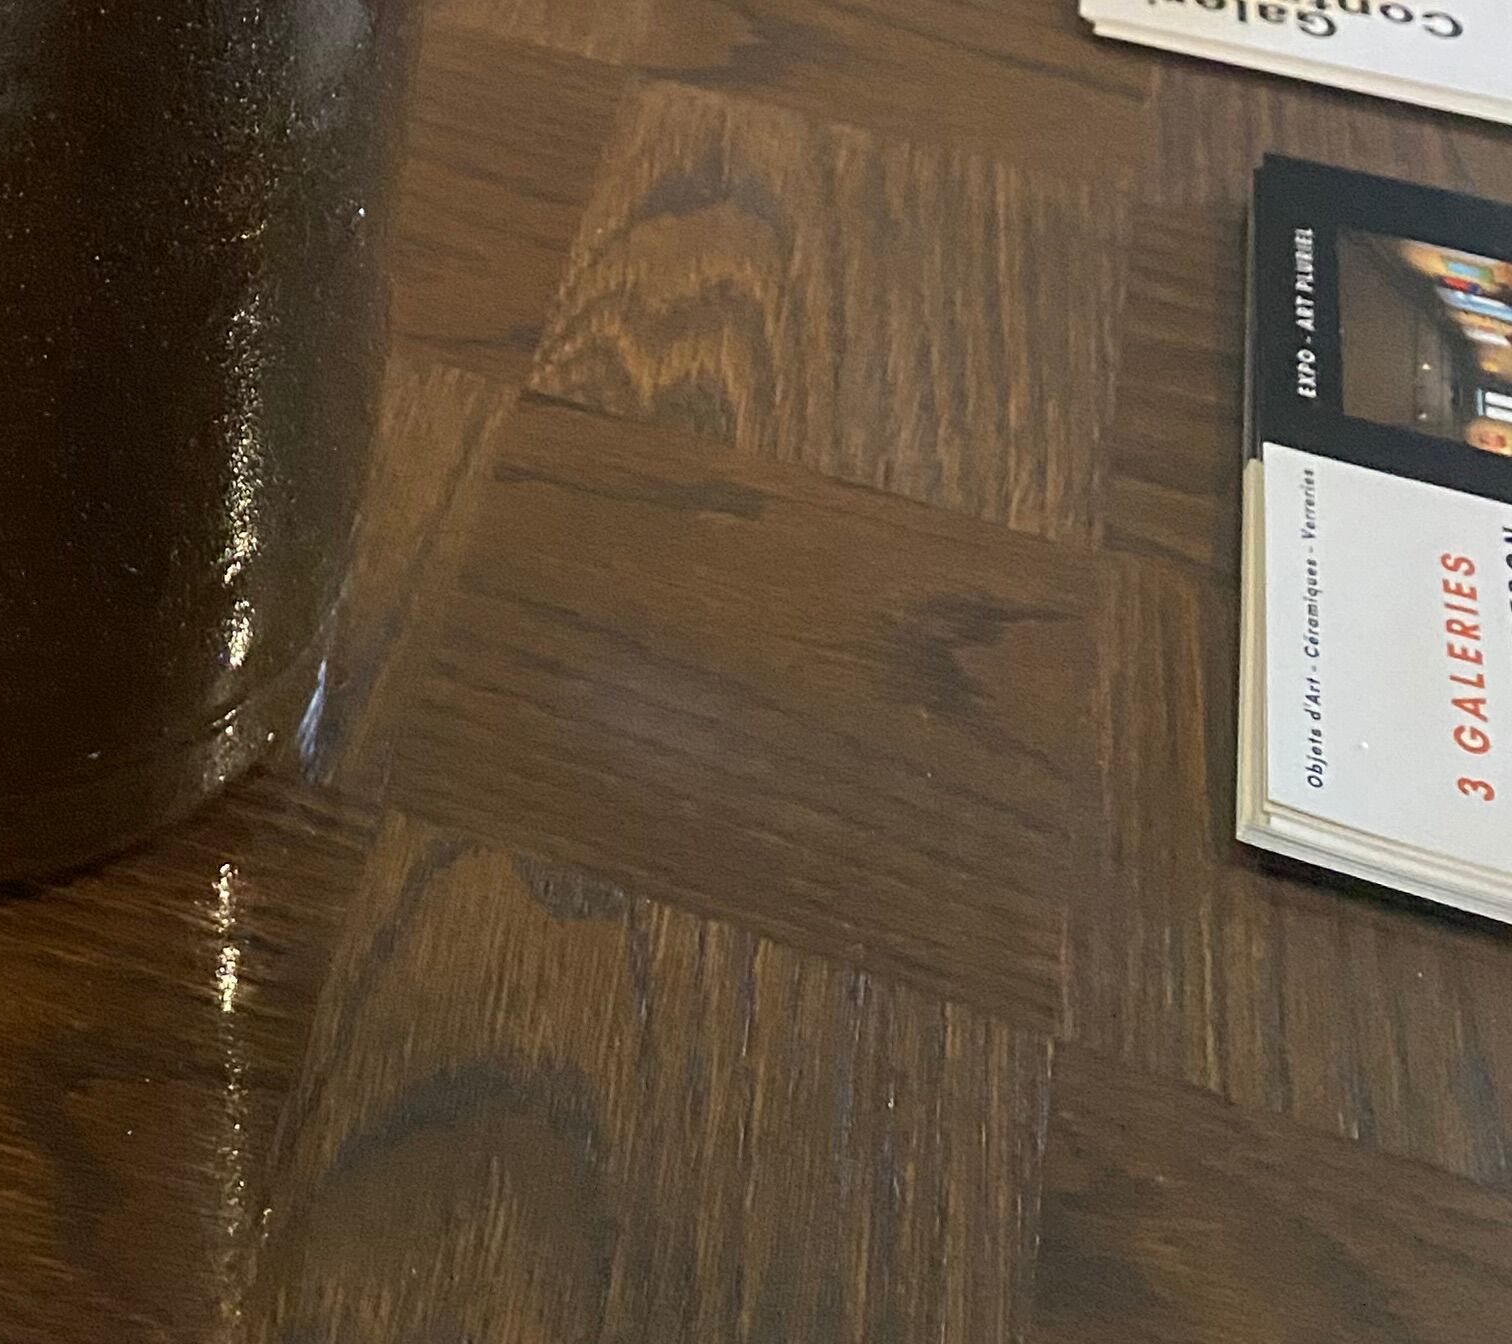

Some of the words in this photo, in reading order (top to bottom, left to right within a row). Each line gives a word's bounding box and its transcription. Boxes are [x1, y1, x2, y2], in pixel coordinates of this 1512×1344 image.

[1294, 227, 1315, 293] PLURIEL
[1295, 295, 1315, 332] ART
[1296, 349, 1317, 399] EXPO
[1298, 469, 1318, 540] Verreries
[1302, 559, 1323, 659] Céramiques
[1439, 552, 1491, 756] GALERIES
[1303, 677, 1322, 720] d'Art
[1306, 728, 1325, 789] Objets
[1456, 777, 1495, 802] 3
